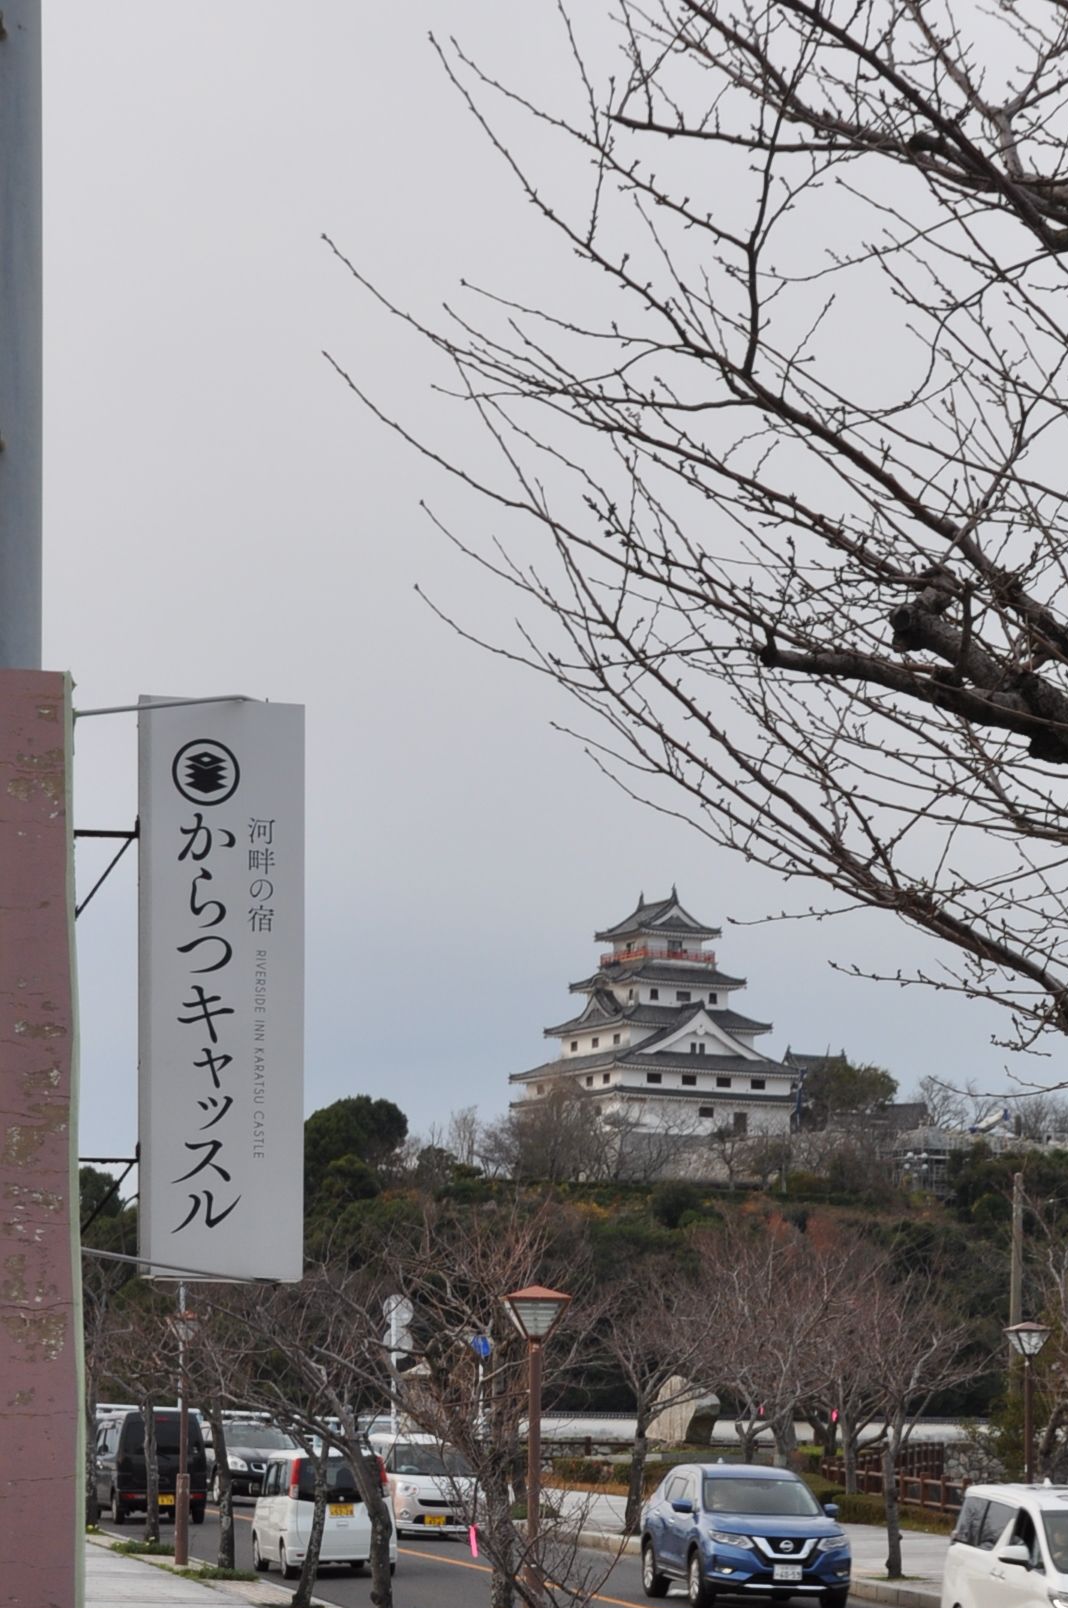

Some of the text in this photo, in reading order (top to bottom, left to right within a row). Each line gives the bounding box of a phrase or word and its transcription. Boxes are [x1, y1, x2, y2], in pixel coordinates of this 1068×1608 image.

[247, 816, 277, 934] 河畔の宿
[170, 811, 242, 1234] からつキャッスル
[253, 949, 267, 1159] RIVERSIDE INN KARATSU CASTLE
